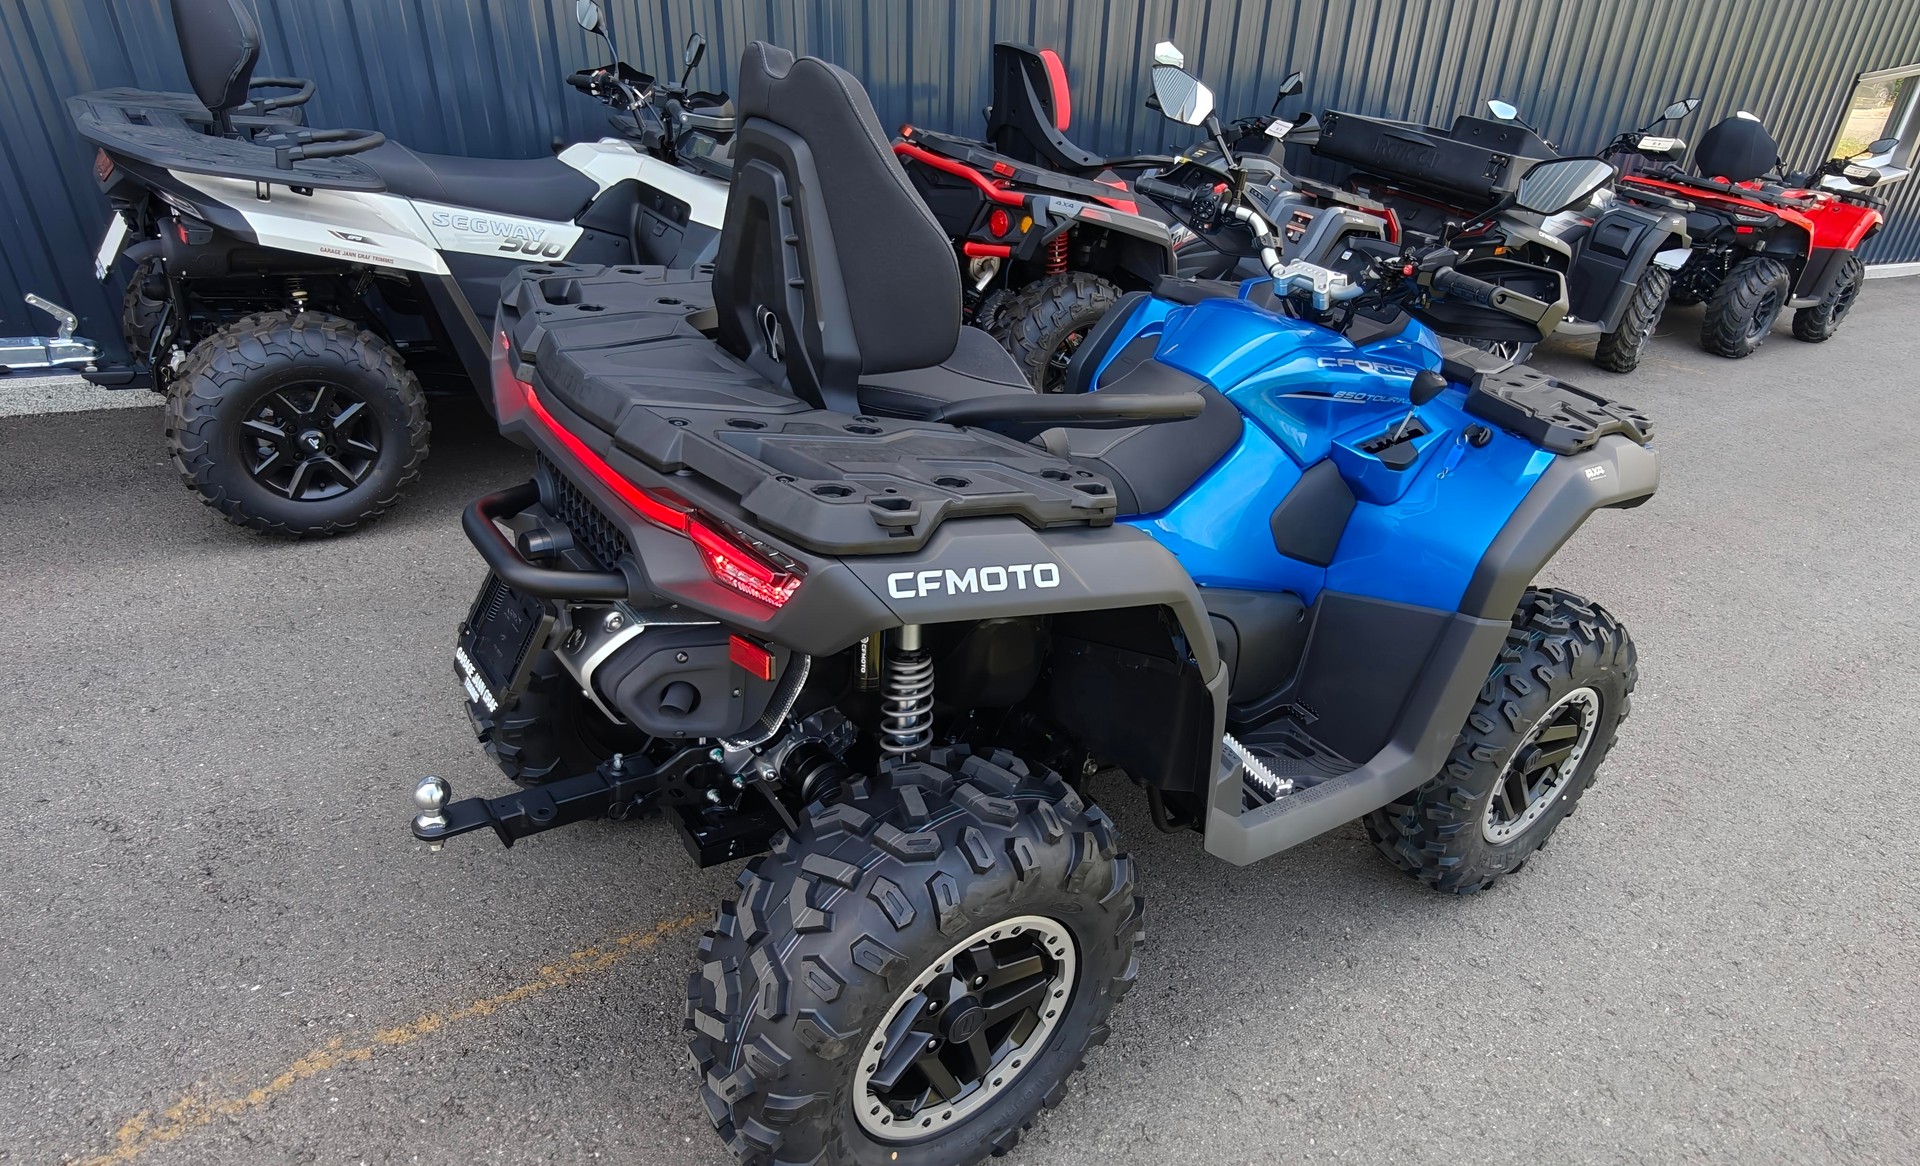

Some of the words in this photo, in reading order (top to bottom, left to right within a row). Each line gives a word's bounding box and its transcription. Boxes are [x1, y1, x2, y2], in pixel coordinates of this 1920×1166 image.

[432, 211, 545, 242] SEGWAY
[320, 246, 341, 256] GARAGE
[1317, 356, 1418, 377] CFORCE
[887, 562, 1061, 599] CFMOTO
[456, 646, 476, 679] GARAGE
[471, 672, 487, 696] JANN
[482, 688, 499, 713] GRAF
